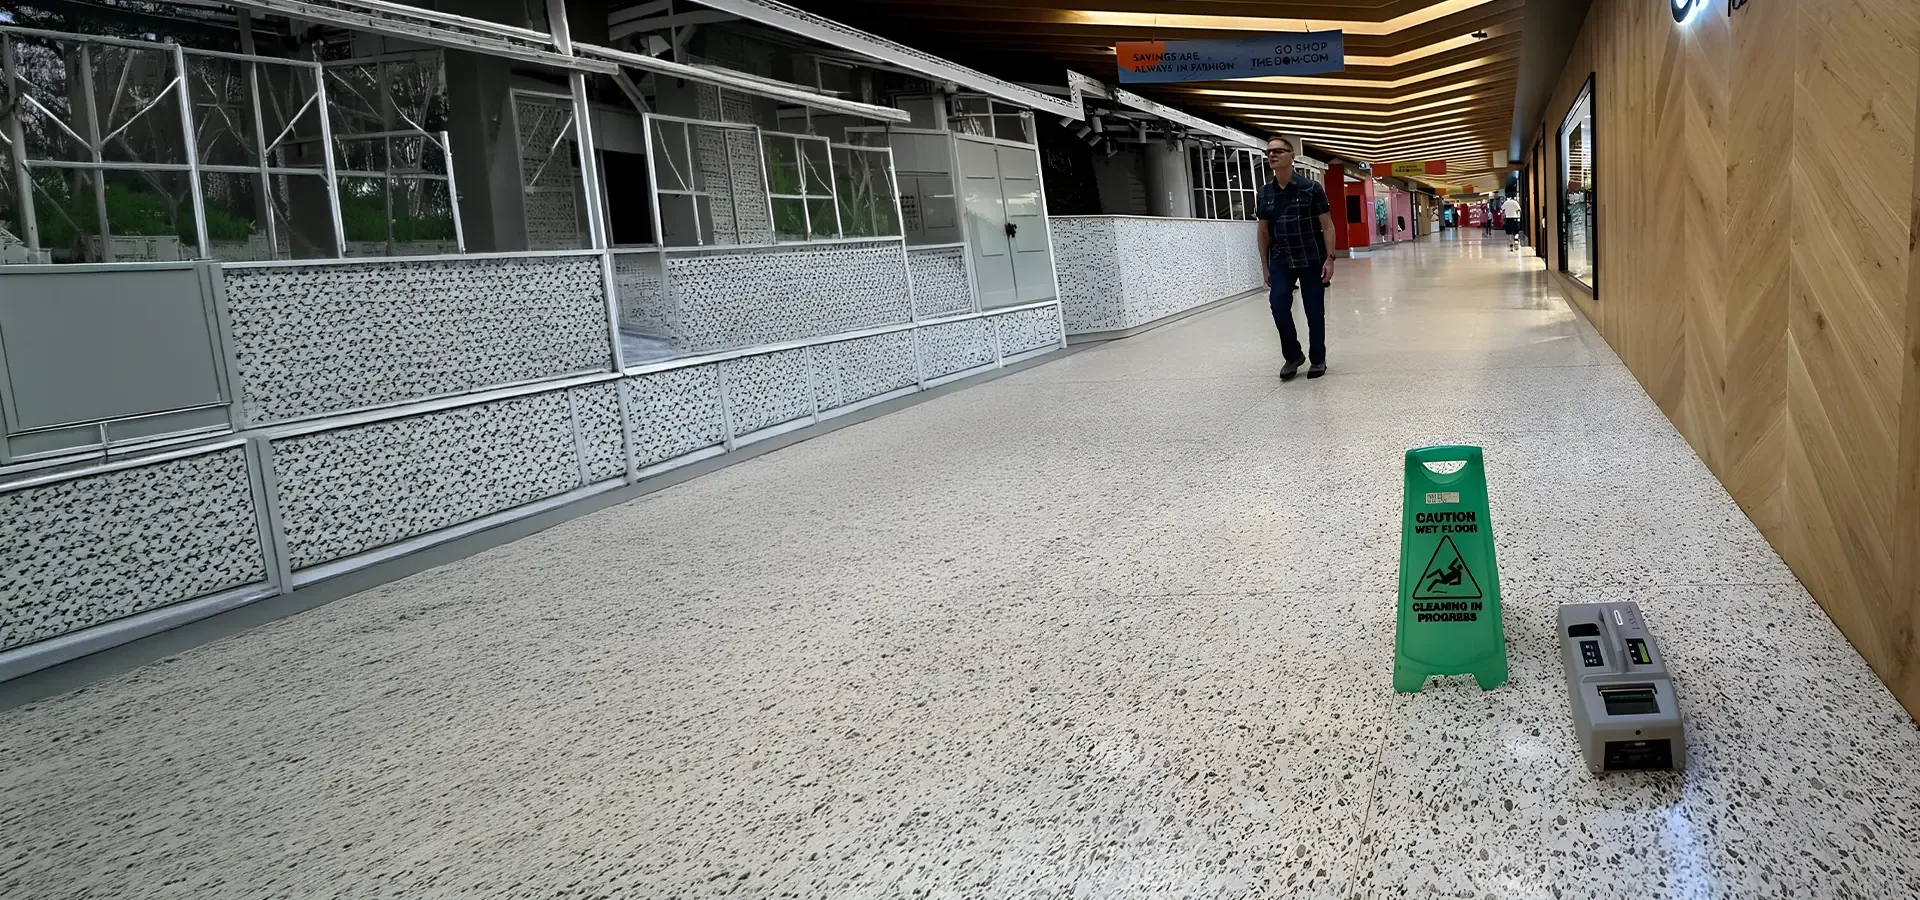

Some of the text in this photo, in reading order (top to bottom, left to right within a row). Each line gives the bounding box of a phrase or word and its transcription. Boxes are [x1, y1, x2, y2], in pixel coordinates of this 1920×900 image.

[1275, 42, 1327, 54] GO SHOP
[1133, 52, 1200, 61] SAVINGS ARE
[1135, 65, 1173, 73] ALWAYS
[1177, 64, 1188, 72] IN
[1416, 511, 1476, 523] CAUTION
[1415, 524, 1478, 534] WET FLOOR
[1412, 601, 1483, 612] CLEANING IN
[1417, 612, 1477, 622] PROGRESS
